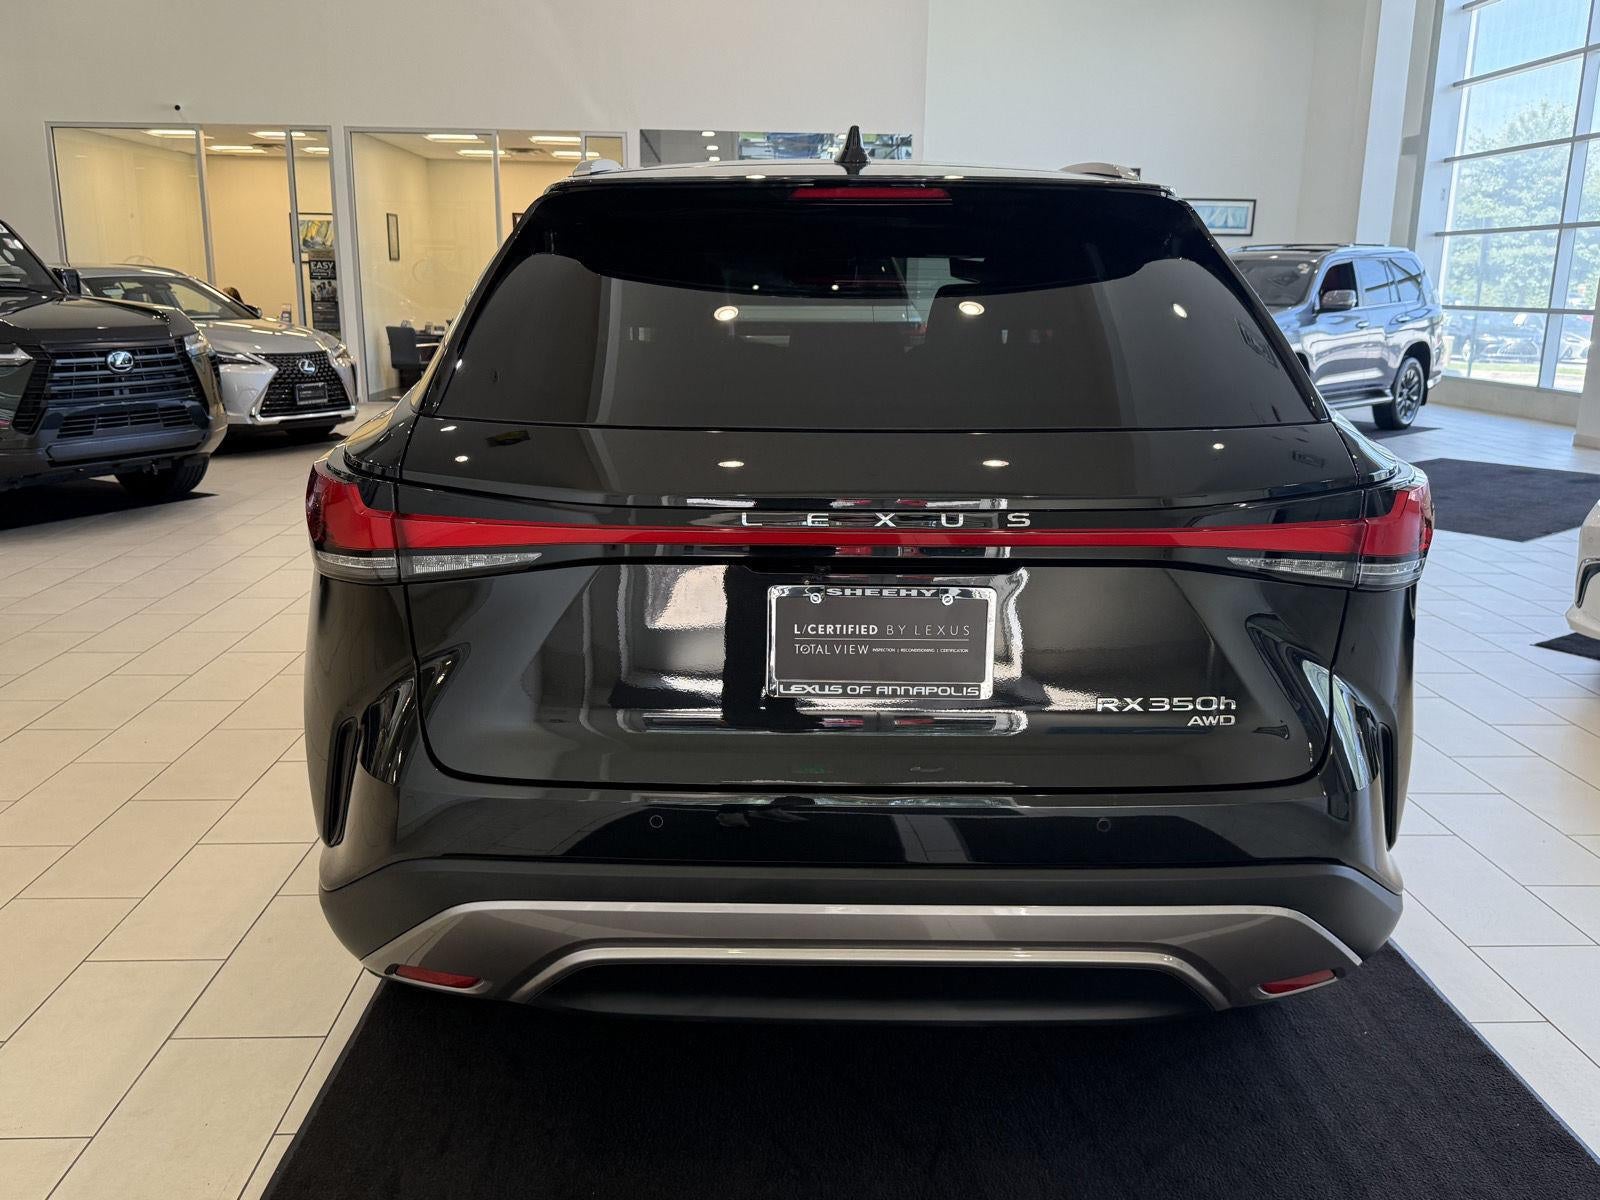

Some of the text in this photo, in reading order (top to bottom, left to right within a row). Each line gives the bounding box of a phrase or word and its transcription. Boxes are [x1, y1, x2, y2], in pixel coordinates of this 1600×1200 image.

[310, 261, 334, 270] EASY
[741, 512, 1031, 528] LEXUS
[826, 588, 937, 597] SHEEHY
[794, 624, 970, 636] L/CERTIFIED BY LEXUS
[794, 644, 831, 655] TOTAL
[834, 644, 869, 655] VIEW
[779, 684, 843, 694] LEXUS
[847, 685, 872, 695] OF
[1096, 696, 1236, 712] RX 350h
[1187, 714, 1236, 726] AWD
